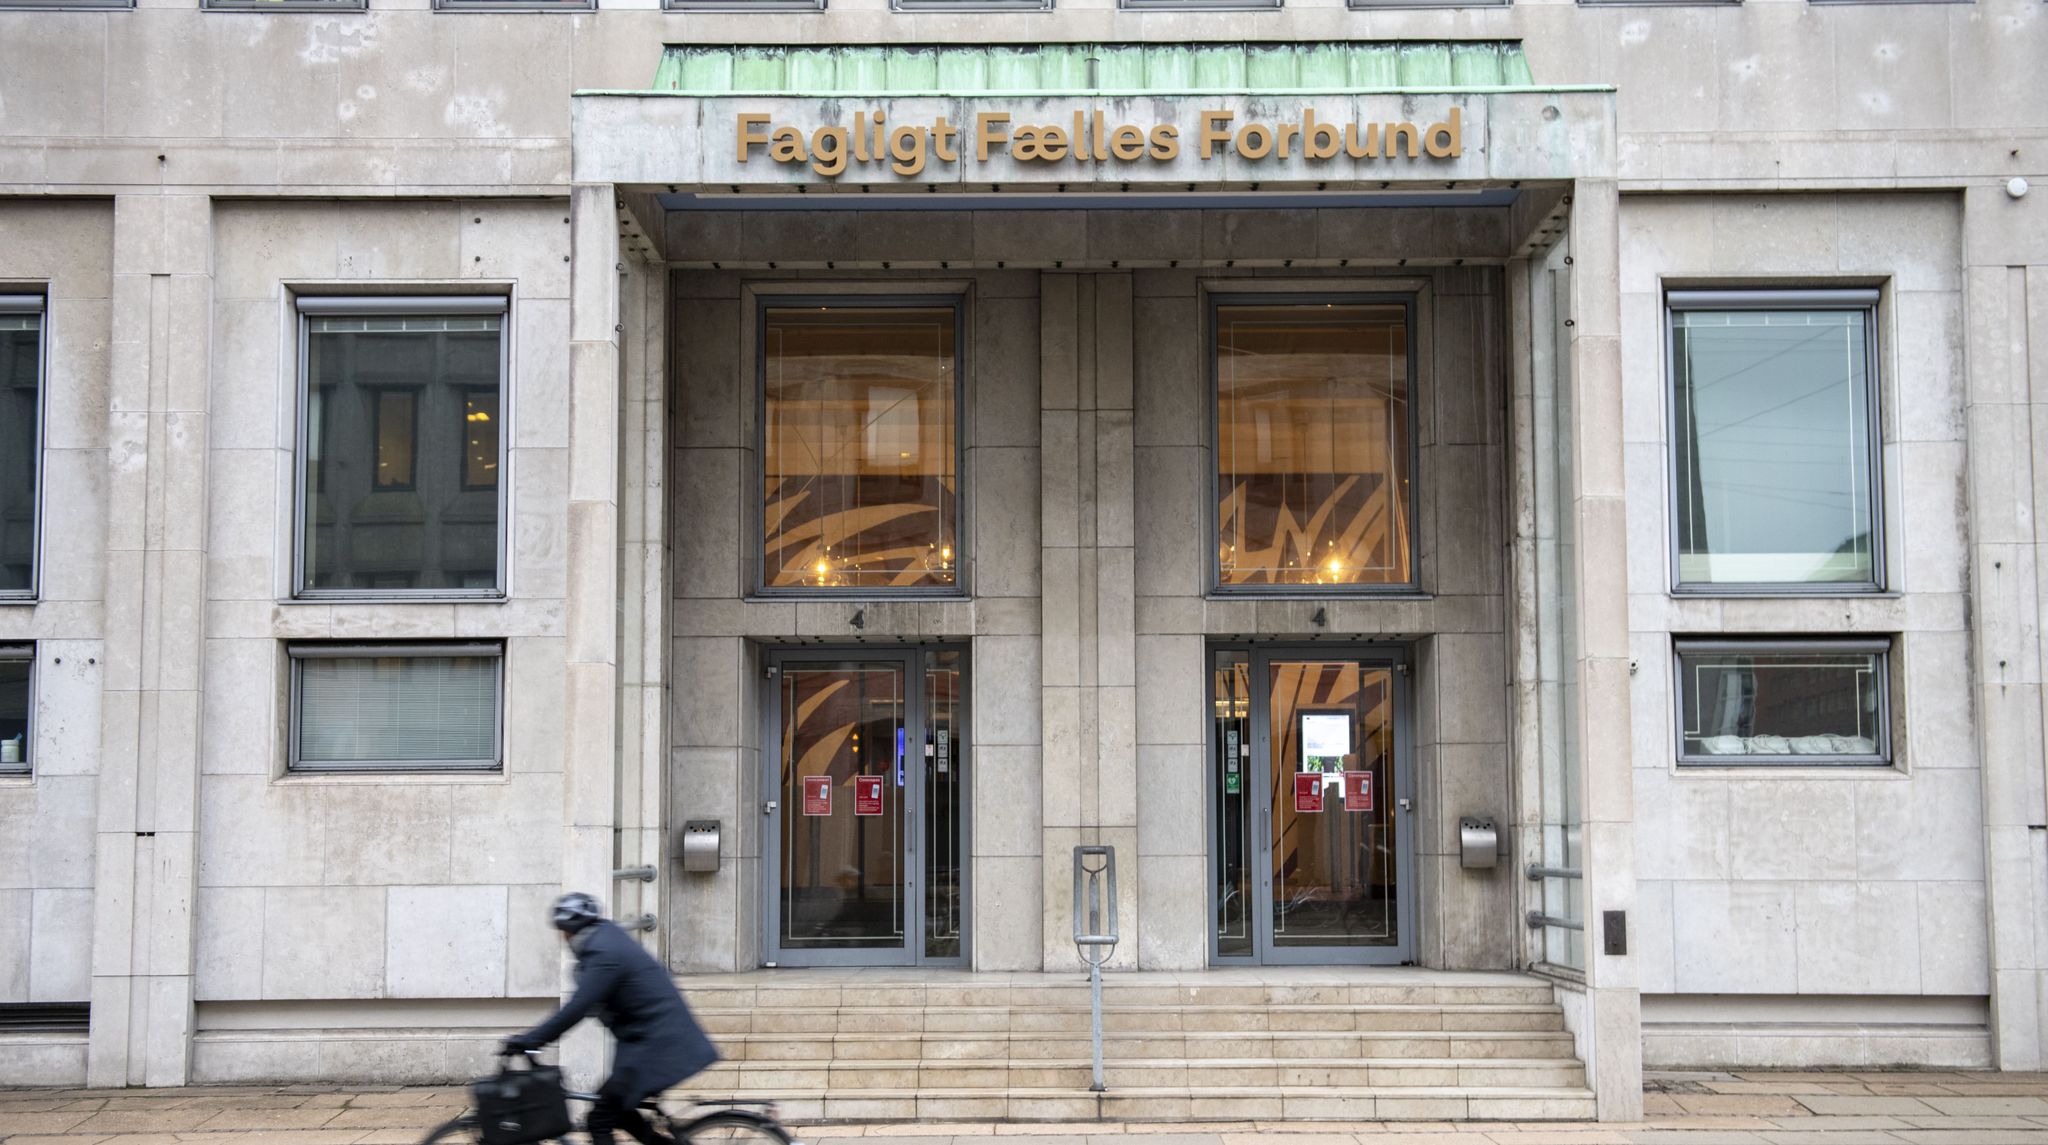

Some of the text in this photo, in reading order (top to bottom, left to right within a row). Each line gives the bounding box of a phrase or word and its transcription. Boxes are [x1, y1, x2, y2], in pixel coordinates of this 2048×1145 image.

[736, 107, 1463, 176] Fagligt Fælles Forbund
